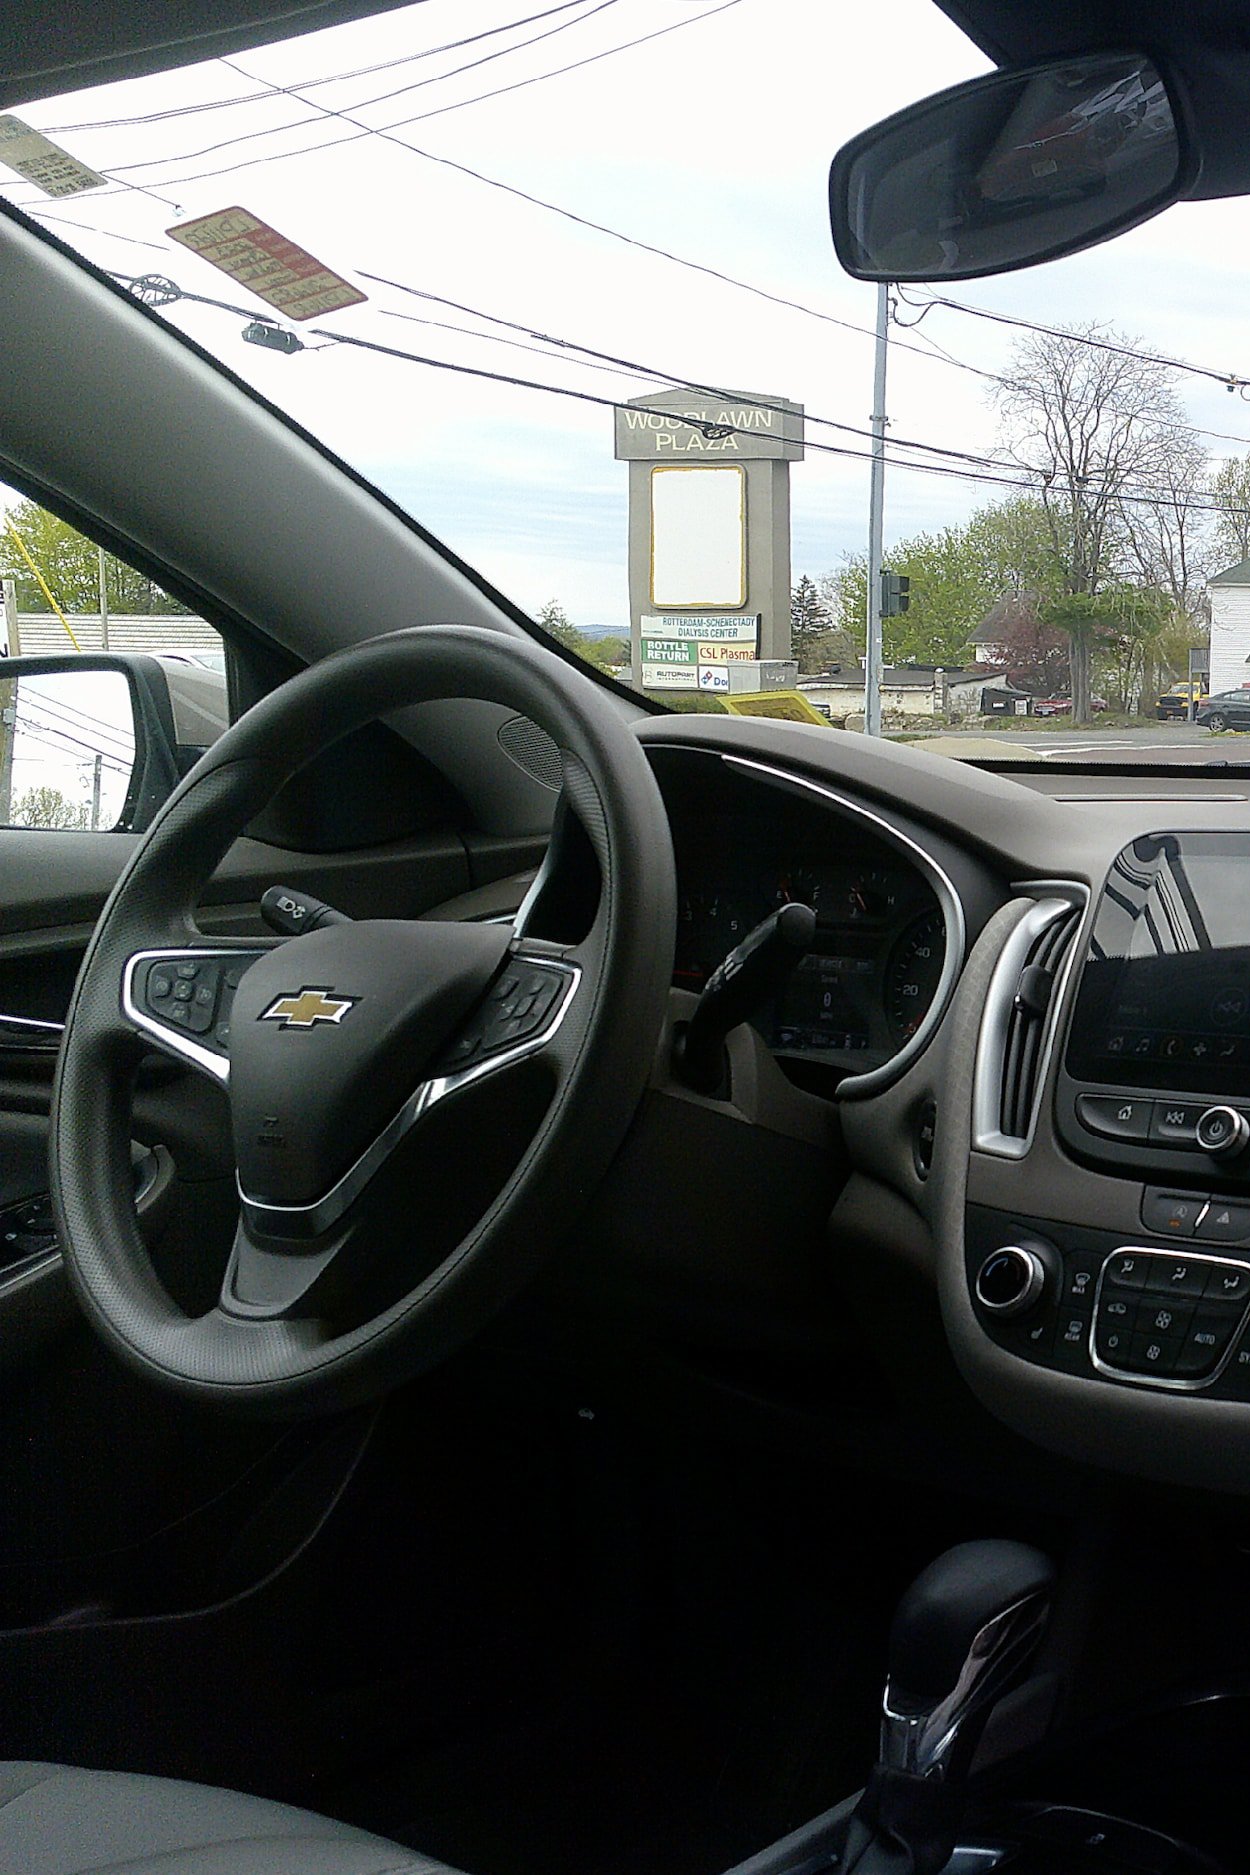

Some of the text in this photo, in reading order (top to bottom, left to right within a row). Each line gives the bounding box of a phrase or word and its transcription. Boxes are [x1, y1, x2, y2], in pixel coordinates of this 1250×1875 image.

[625, 410, 772, 430] WOODLAWN
[655, 432, 739, 451] PLAZA
[662, 617, 755, 627] ROTTERDAM-SCHENECTADY
[678, 627, 739, 638] DIALYSIS CENTER
[647, 641, 689, 651] BOTTLE
[647, 650, 689, 662] RETURN
[700, 647, 755, 661] CSL Plasma
[714, 677, 728, 686] Do
[915, 947, 930, 958] 40
[903, 984, 919, 996] 20
[1193, 1332, 1217, 1346] AUTO
